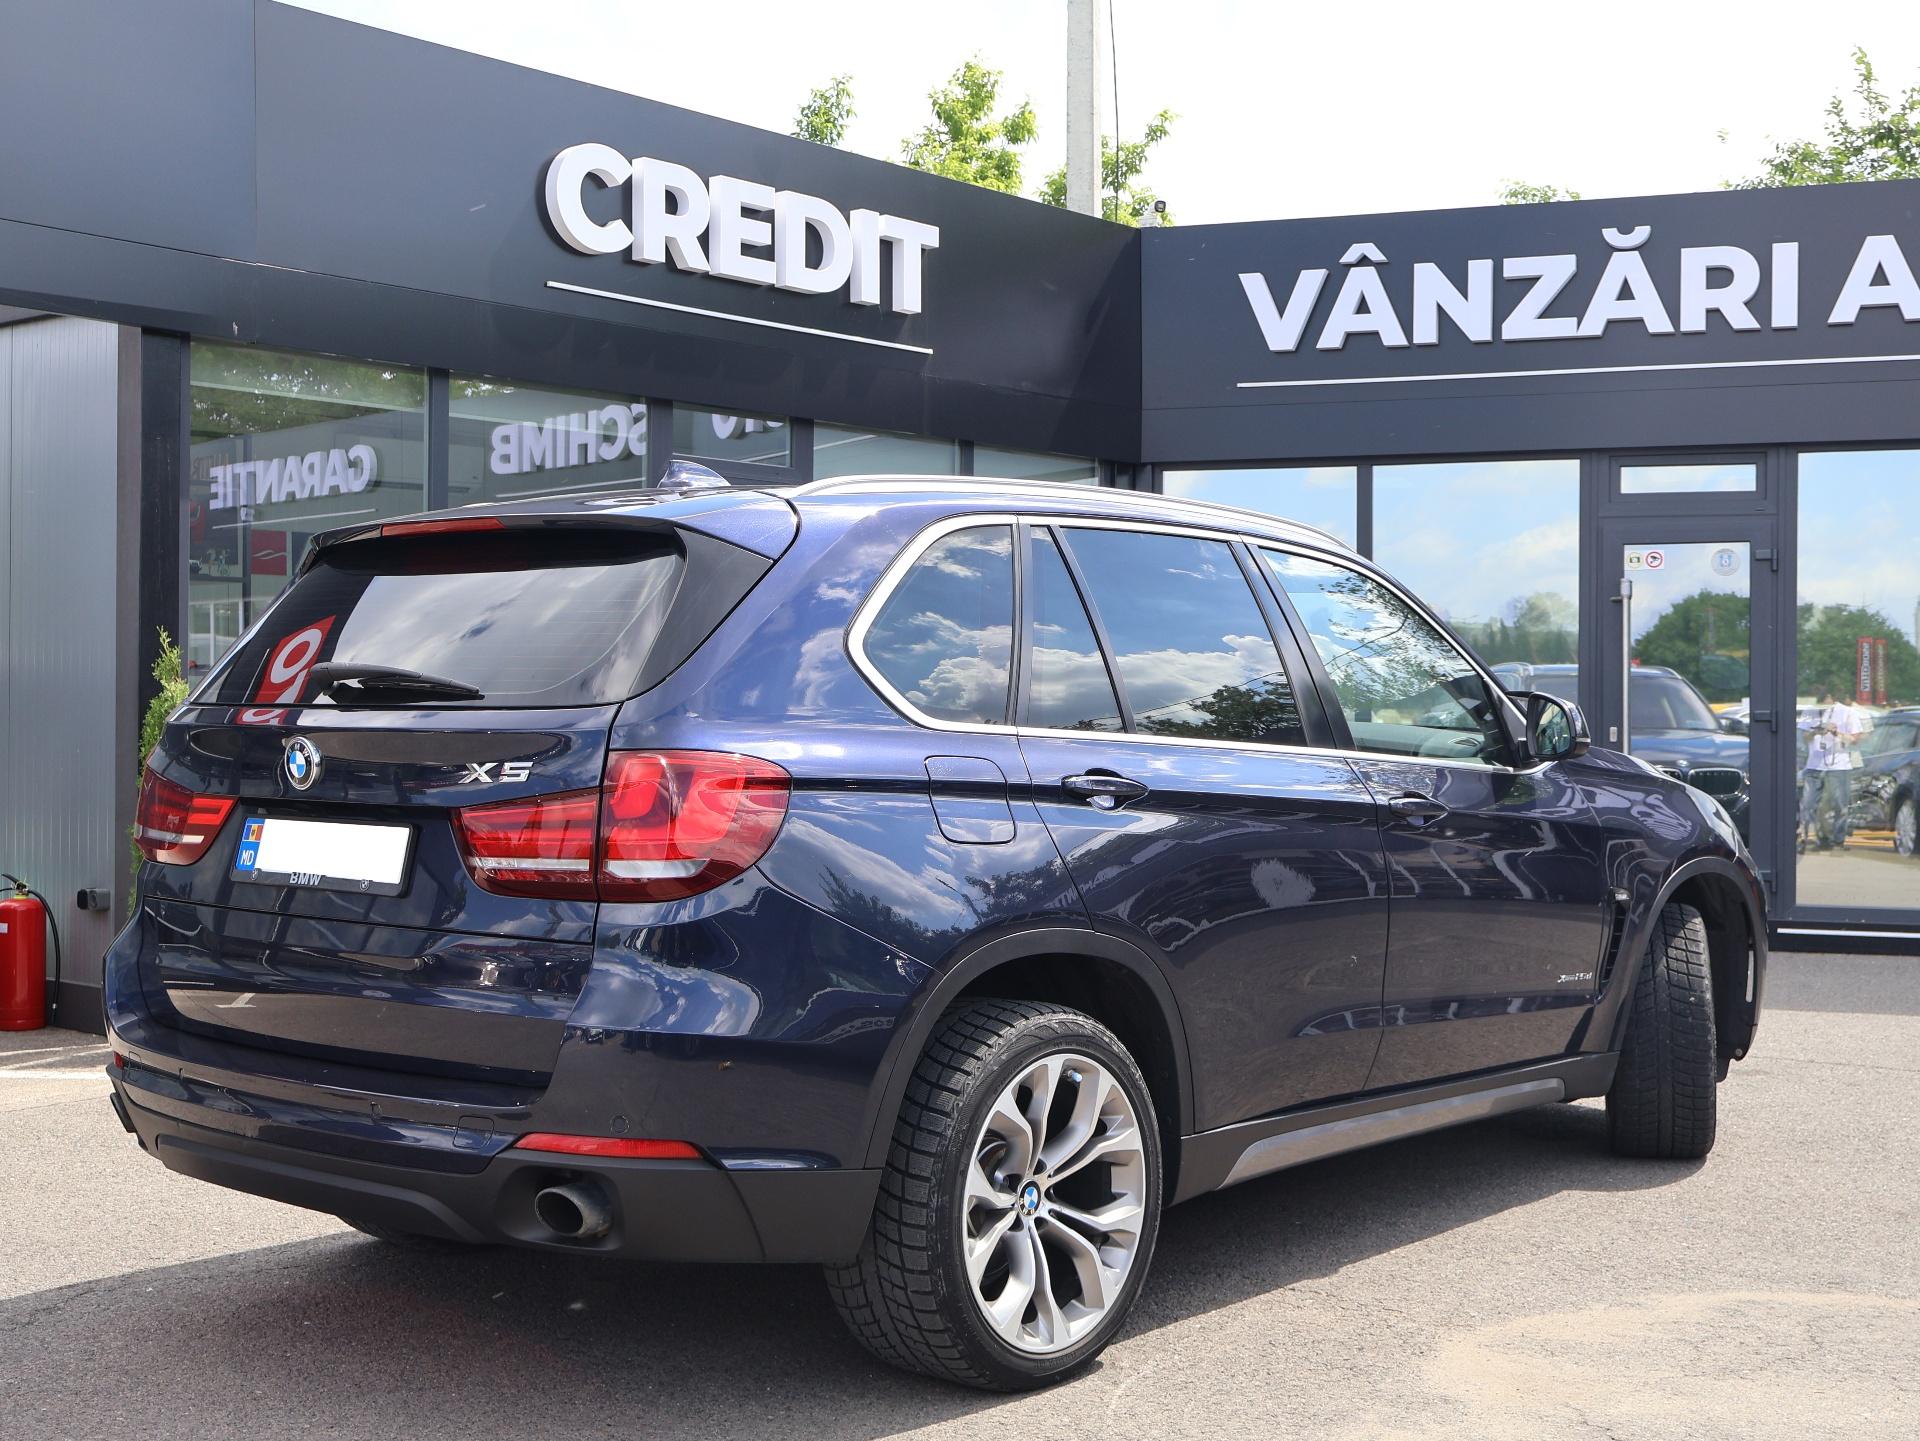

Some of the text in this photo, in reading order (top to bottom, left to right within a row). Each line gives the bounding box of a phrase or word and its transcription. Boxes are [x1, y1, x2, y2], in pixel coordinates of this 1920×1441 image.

[545, 142, 939, 315] CREDIT
[1238, 225, 1799, 353] VÂNZĂRI
[458, 761, 534, 784] X5
[240, 849, 255, 866] MD
[289, 872, 321, 886] BMW
